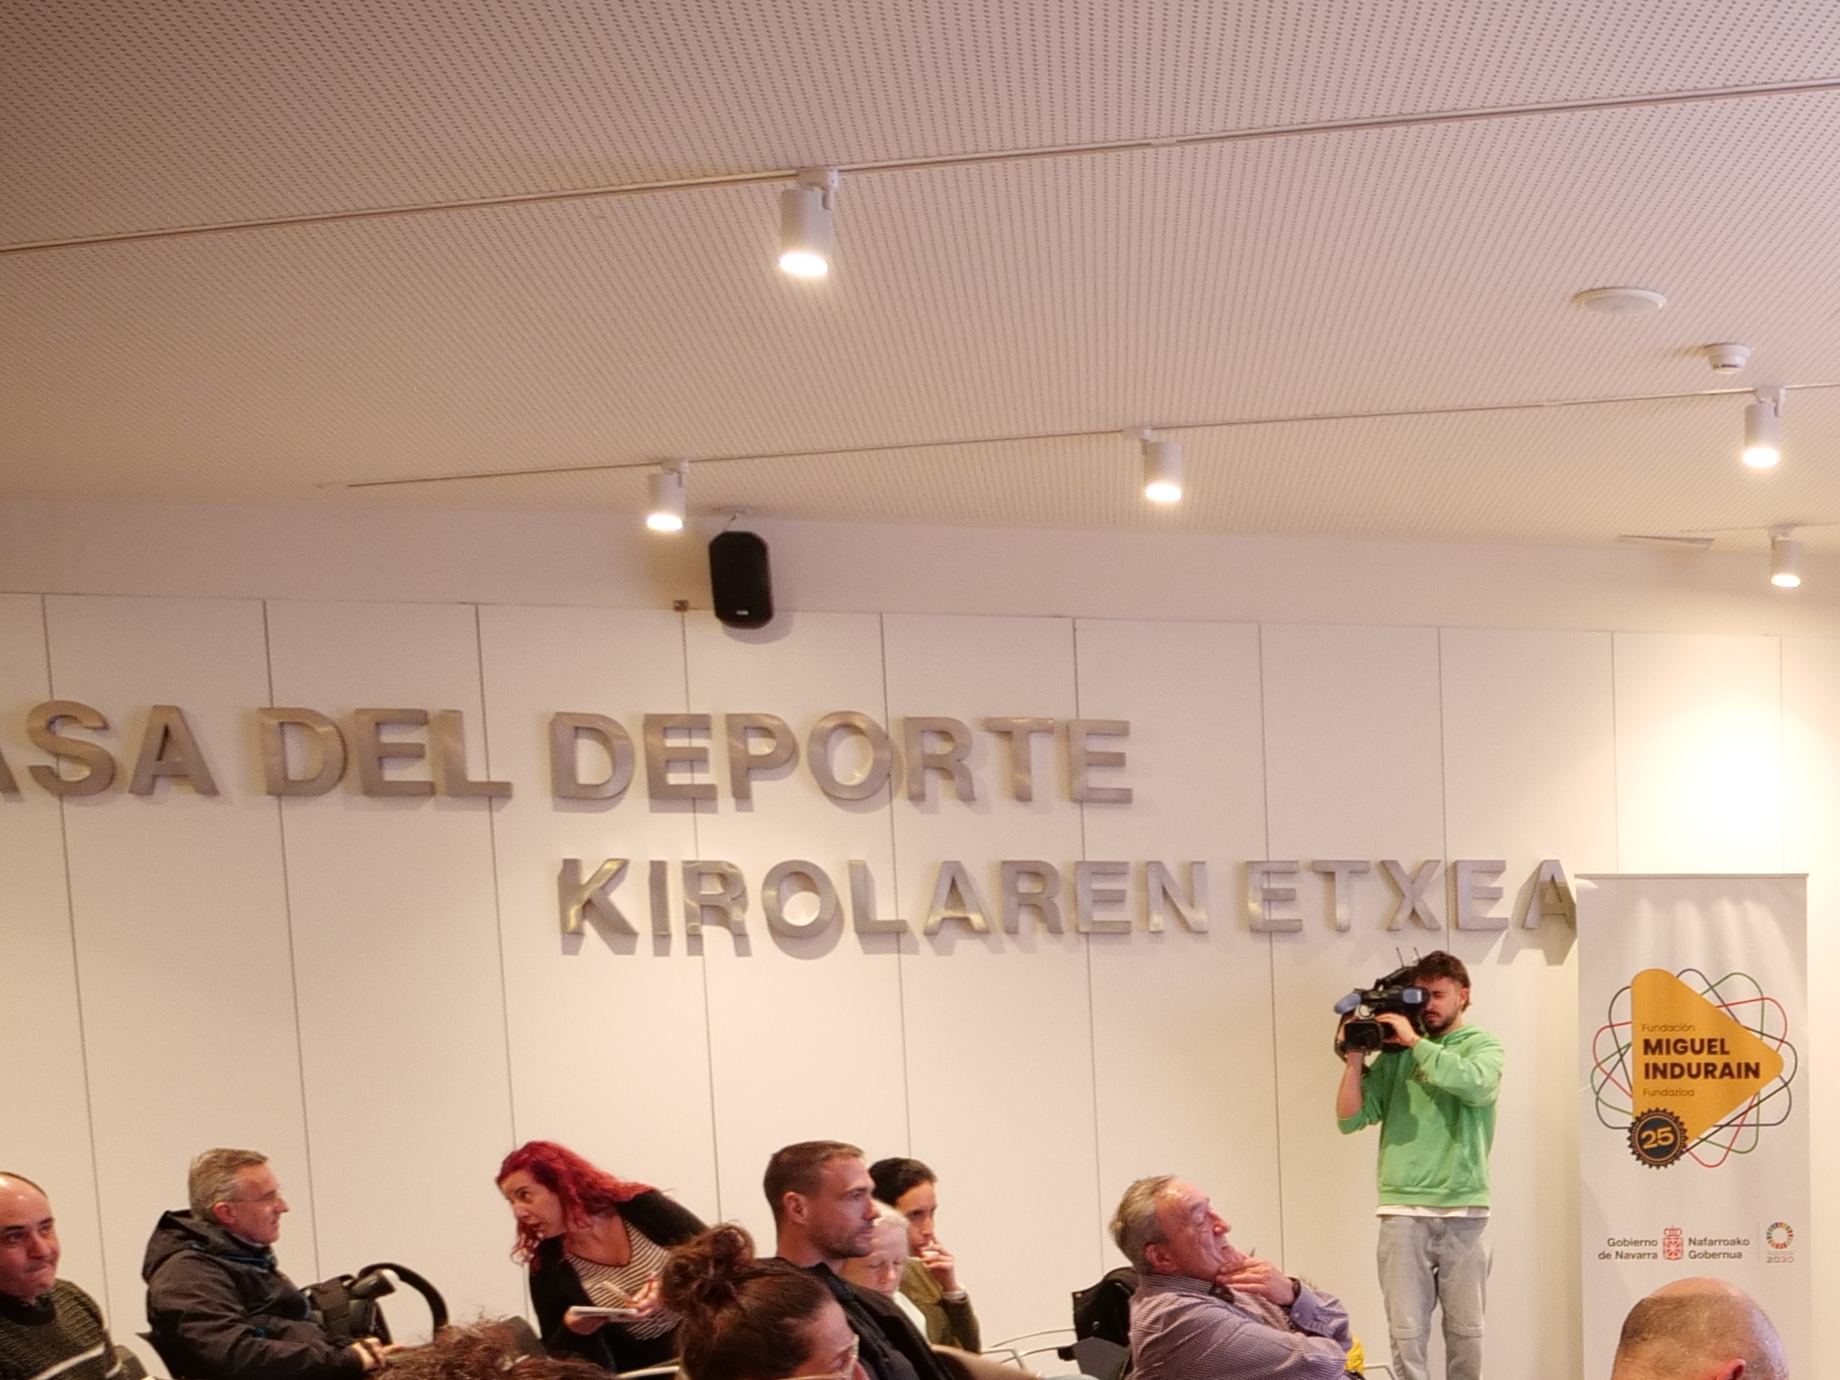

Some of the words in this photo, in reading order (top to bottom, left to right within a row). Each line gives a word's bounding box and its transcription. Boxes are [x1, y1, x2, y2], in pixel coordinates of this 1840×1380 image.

[0, 699, 219, 798] SA
[259, 706, 514, 799] DEL
[550, 711, 1133, 805] DEPORTE
[557, 857, 1209, 940] KIROLAREN
[1245, 858, 1577, 933] ETXEA
[1641, 1022, 1696, 1033] Fundación
[1642, 1038, 1731, 1056] MIGUEL
[1643, 1061, 1761, 1080] INDURAIN
[1642, 1087, 1695, 1098] Fundazioa
[1640, 1126, 1675, 1150] 25
[1607, 1236, 1658, 1248] Gobierno
[1688, 1236, 1750, 1248] Nafarroako
[1598, 1250, 1612, 1261] de
[1615, 1250, 1659, 1261] Navarra
[1688, 1250, 1743, 1261] Gobernua
[1765, 1256, 1795, 1264] 2030
